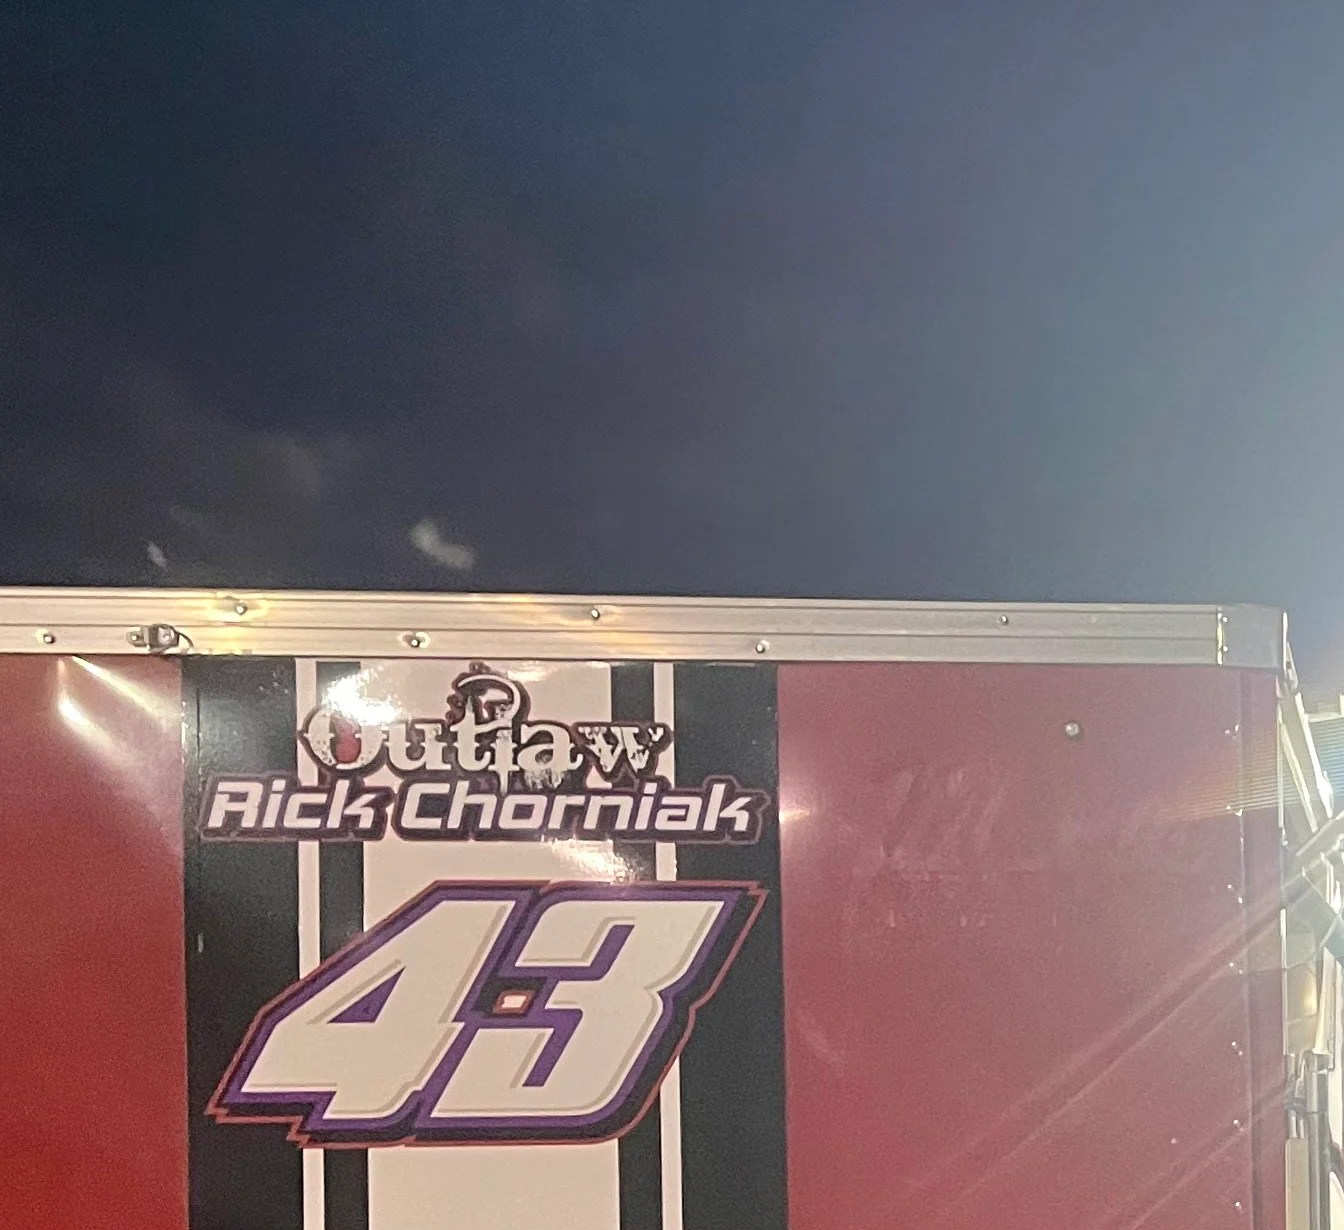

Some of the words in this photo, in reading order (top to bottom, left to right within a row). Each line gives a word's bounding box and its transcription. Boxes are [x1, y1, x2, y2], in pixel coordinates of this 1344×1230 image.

[298, 678, 672, 786] Outlaw
[205, 781, 380, 832] Rick
[399, 779, 757, 832] Chorniak
[218, 885, 745, 1138] 43
